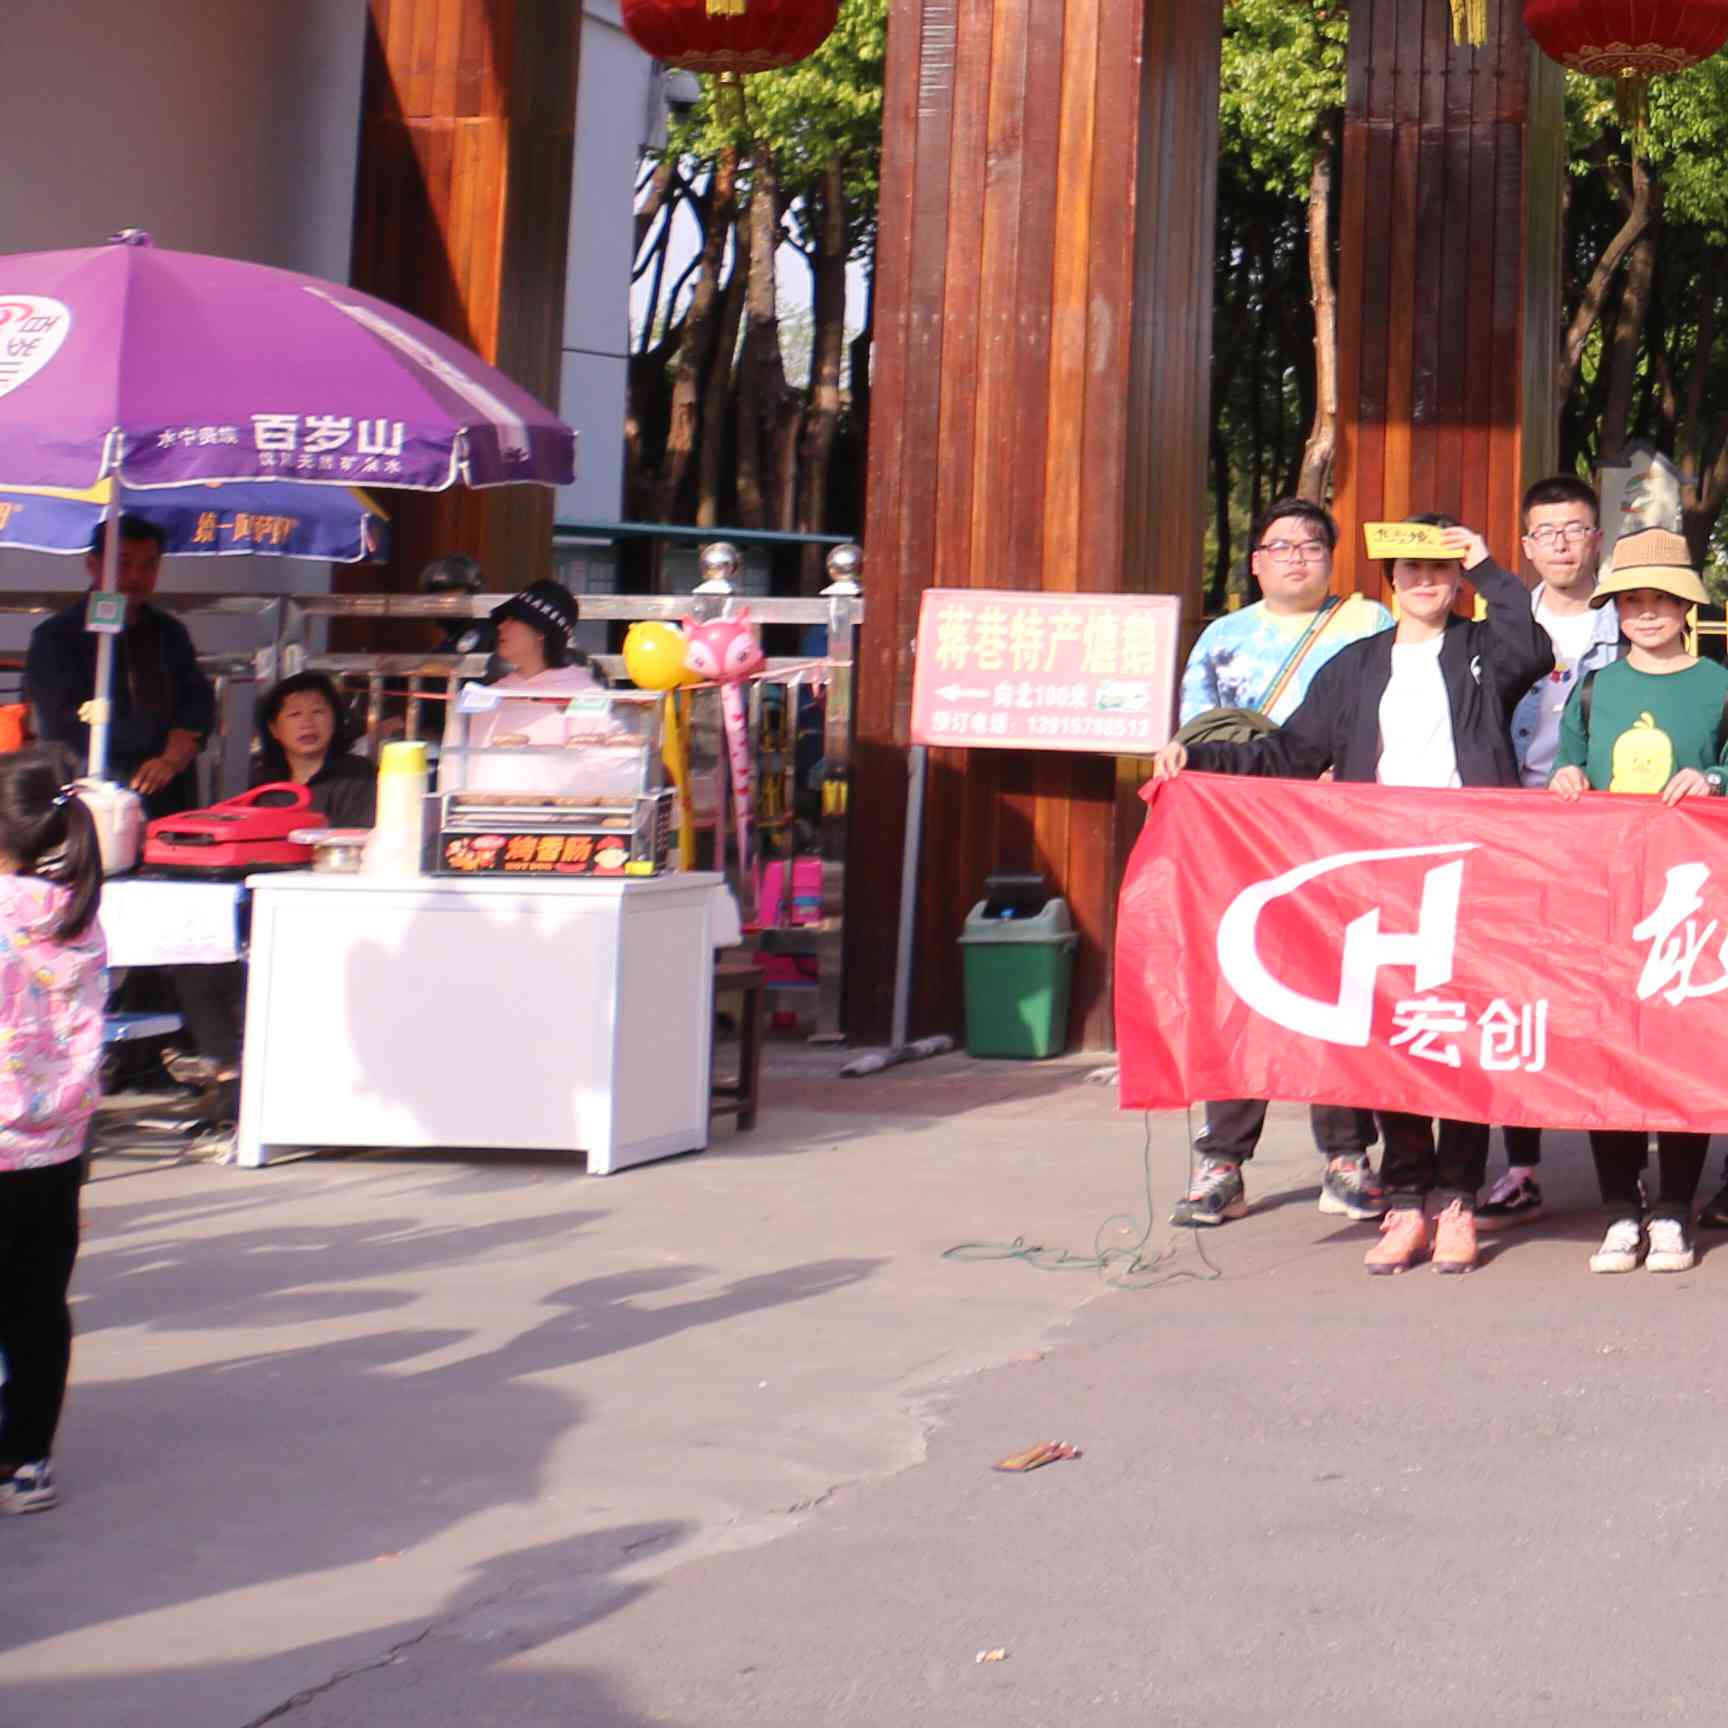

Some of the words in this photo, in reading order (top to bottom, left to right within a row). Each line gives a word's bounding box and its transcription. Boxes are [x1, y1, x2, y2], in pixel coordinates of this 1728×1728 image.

[250, 413, 405, 456] 百岁山
[1390, 999, 1549, 1072] 宏创
